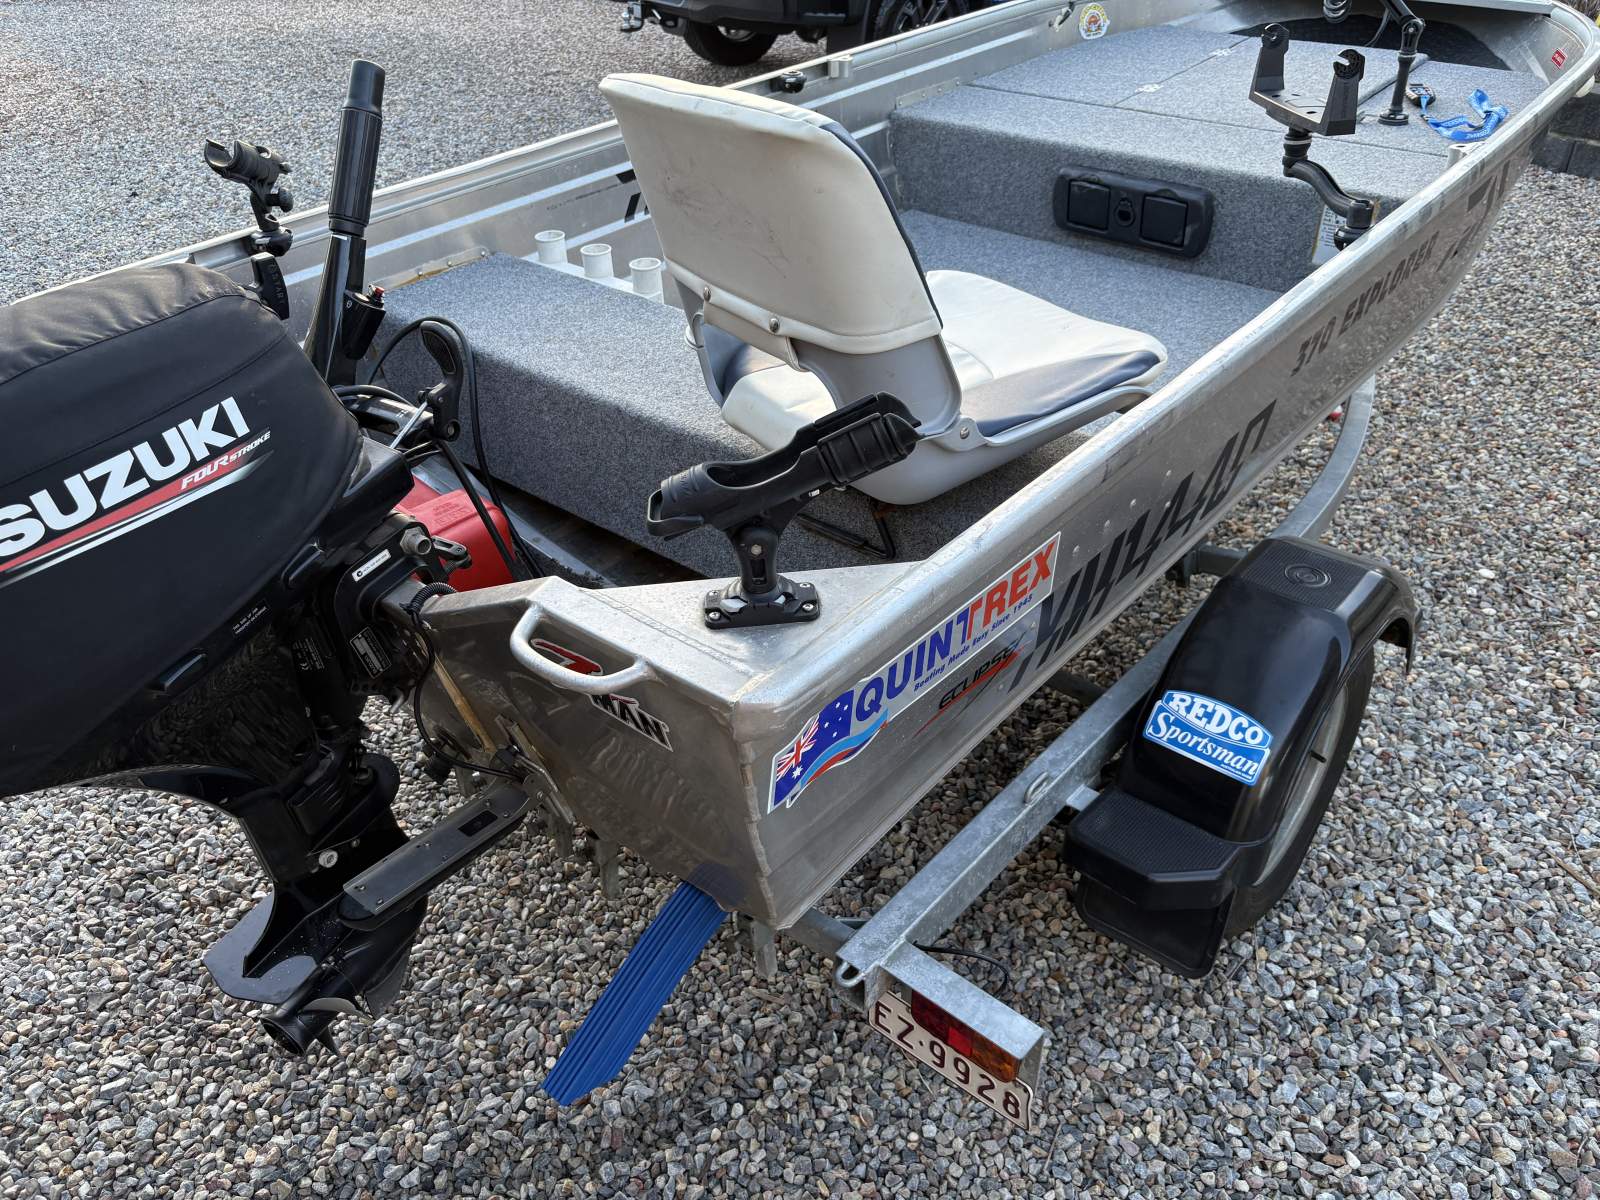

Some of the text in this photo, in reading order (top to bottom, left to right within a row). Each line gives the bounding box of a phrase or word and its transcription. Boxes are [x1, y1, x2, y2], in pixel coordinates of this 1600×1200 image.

[1290, 230, 1441, 378] 370 EXPLORER
[0, 396, 251, 557] SUZUKI
[855, 540, 1056, 722] QUINTREX
[1147, 711, 1260, 776] Sportsman
[1168, 692, 1265, 745] REDCO
